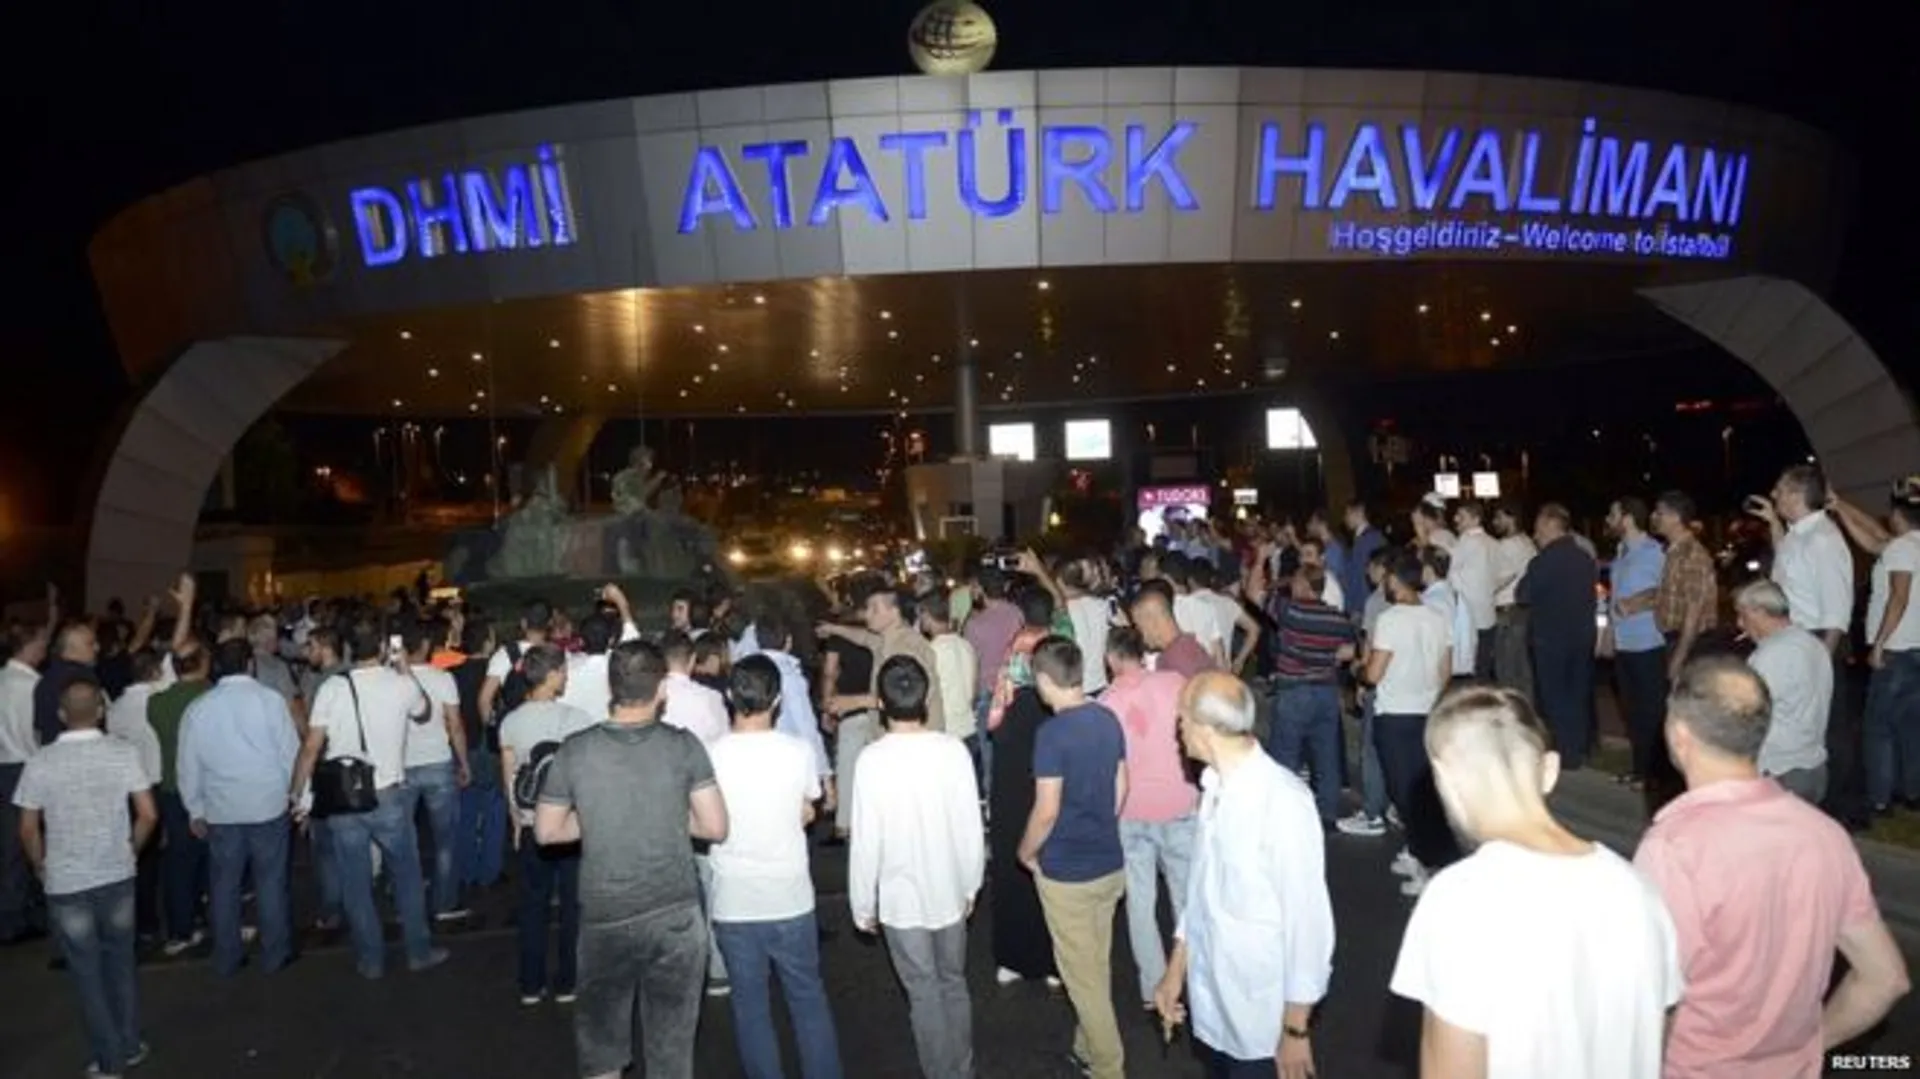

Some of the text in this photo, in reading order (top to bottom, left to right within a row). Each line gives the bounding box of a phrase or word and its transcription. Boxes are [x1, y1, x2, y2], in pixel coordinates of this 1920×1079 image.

[351, 109, 1746, 266] DHMİ ATATÜRK HAVALİMANI
[1634, 229, 1654, 254] to
